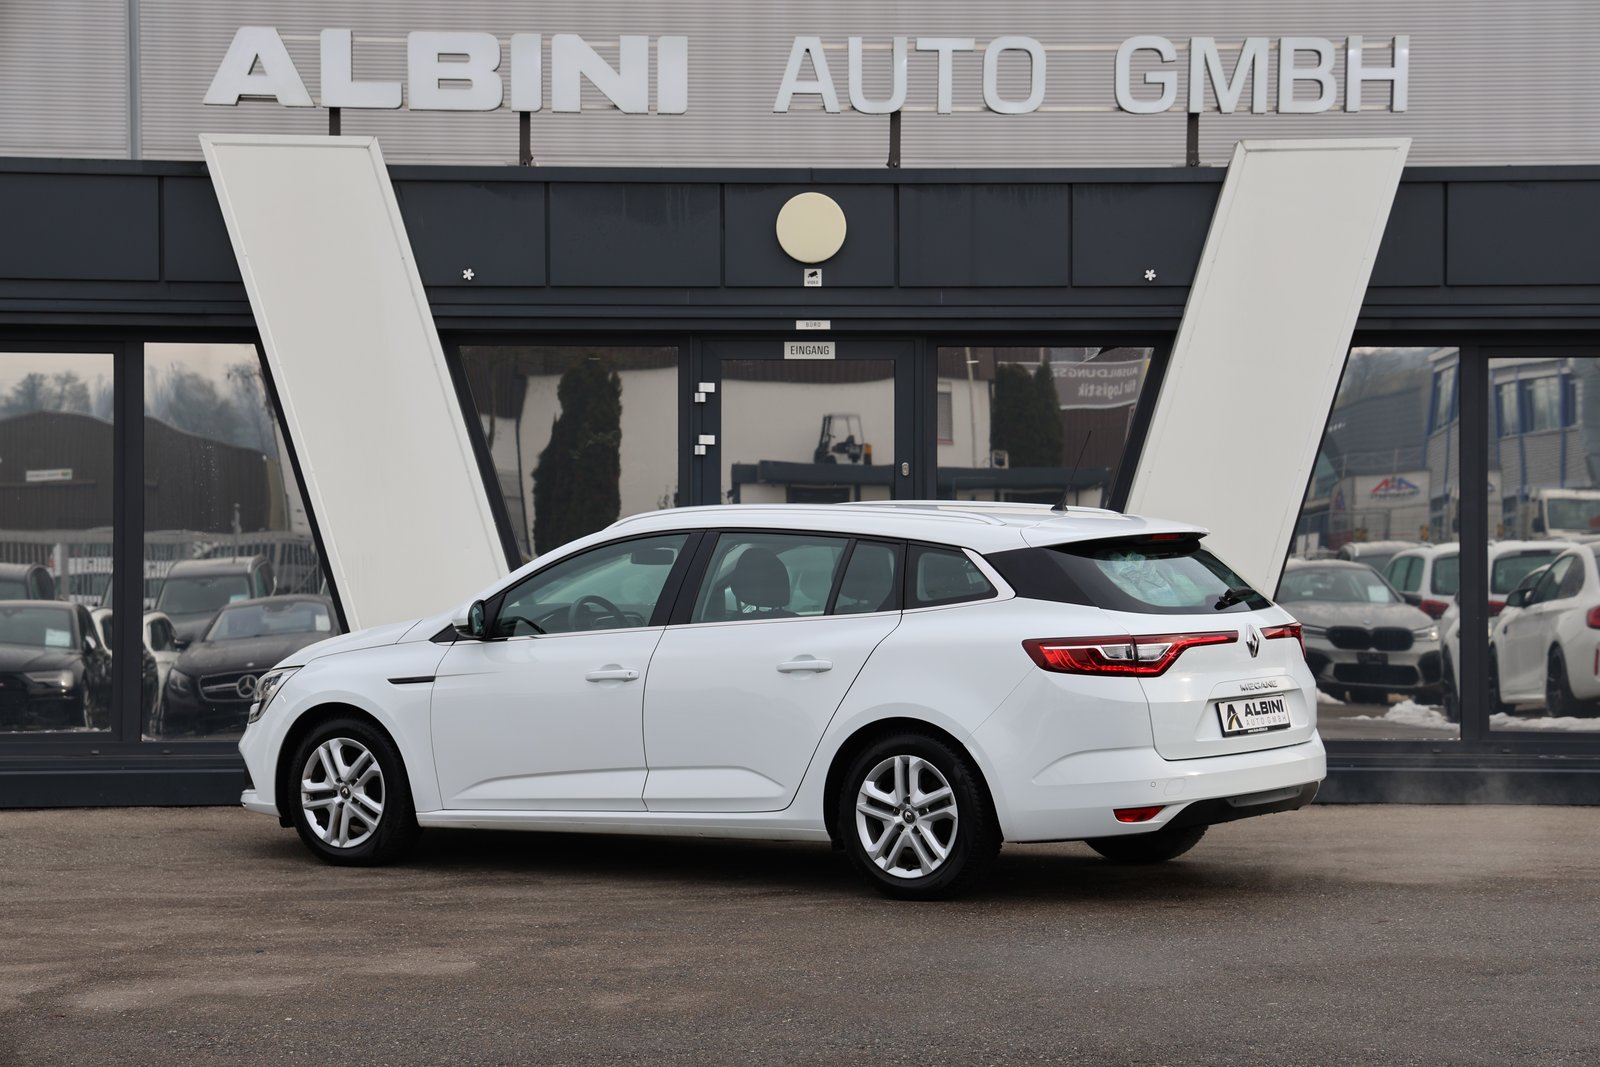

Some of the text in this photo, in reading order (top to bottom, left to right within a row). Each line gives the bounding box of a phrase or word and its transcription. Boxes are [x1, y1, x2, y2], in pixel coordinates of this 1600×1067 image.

[203, 25, 1411, 115] ALBINI AUTO GMBH
[790, 345, 830, 355] EINGANG
[1240, 680, 1278, 691] MEGANE
[1245, 700, 1284, 717] ALBINI
[1246, 715, 1287, 726] AUTO GMBH
